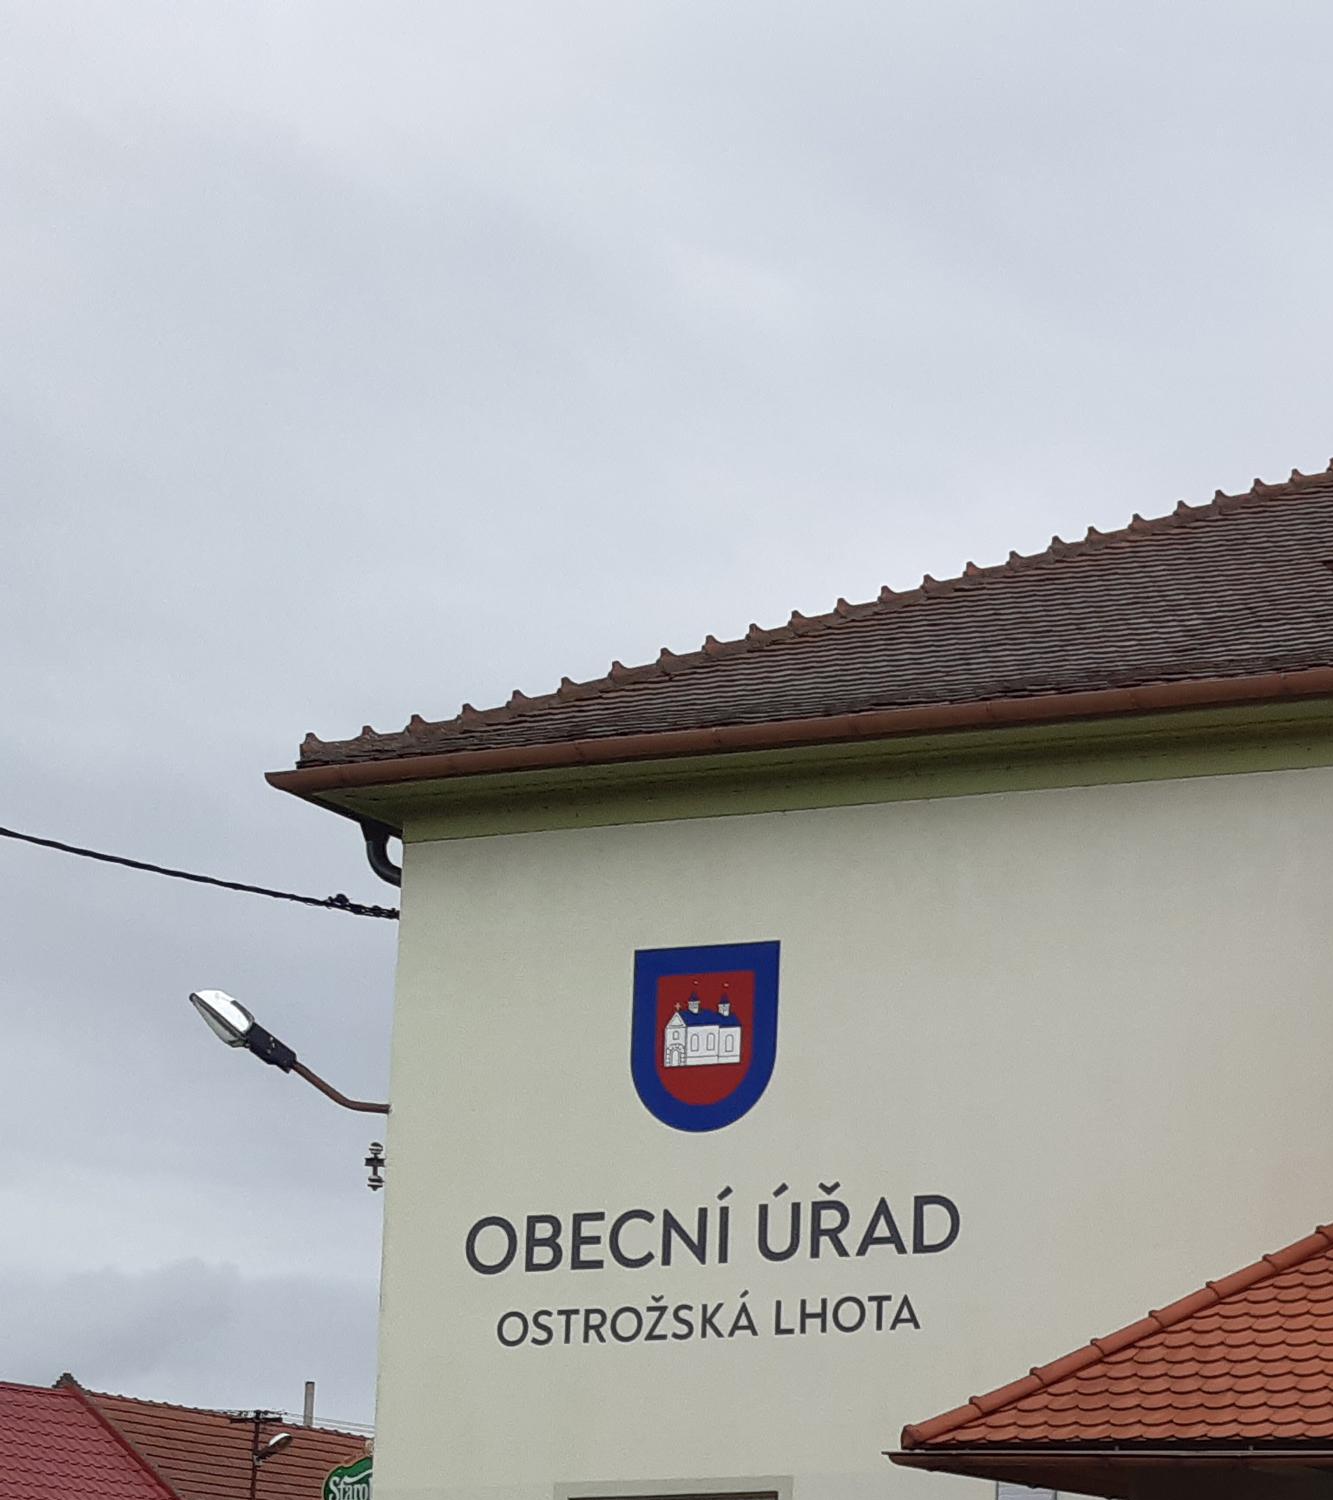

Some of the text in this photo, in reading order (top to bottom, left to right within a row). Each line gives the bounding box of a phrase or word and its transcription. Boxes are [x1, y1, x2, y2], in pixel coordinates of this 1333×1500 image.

[465, 1180, 961, 1275] OBECNÍ ÚŘAD
[496, 1290, 922, 1347] OSTROŽSKÁ LHOTA
